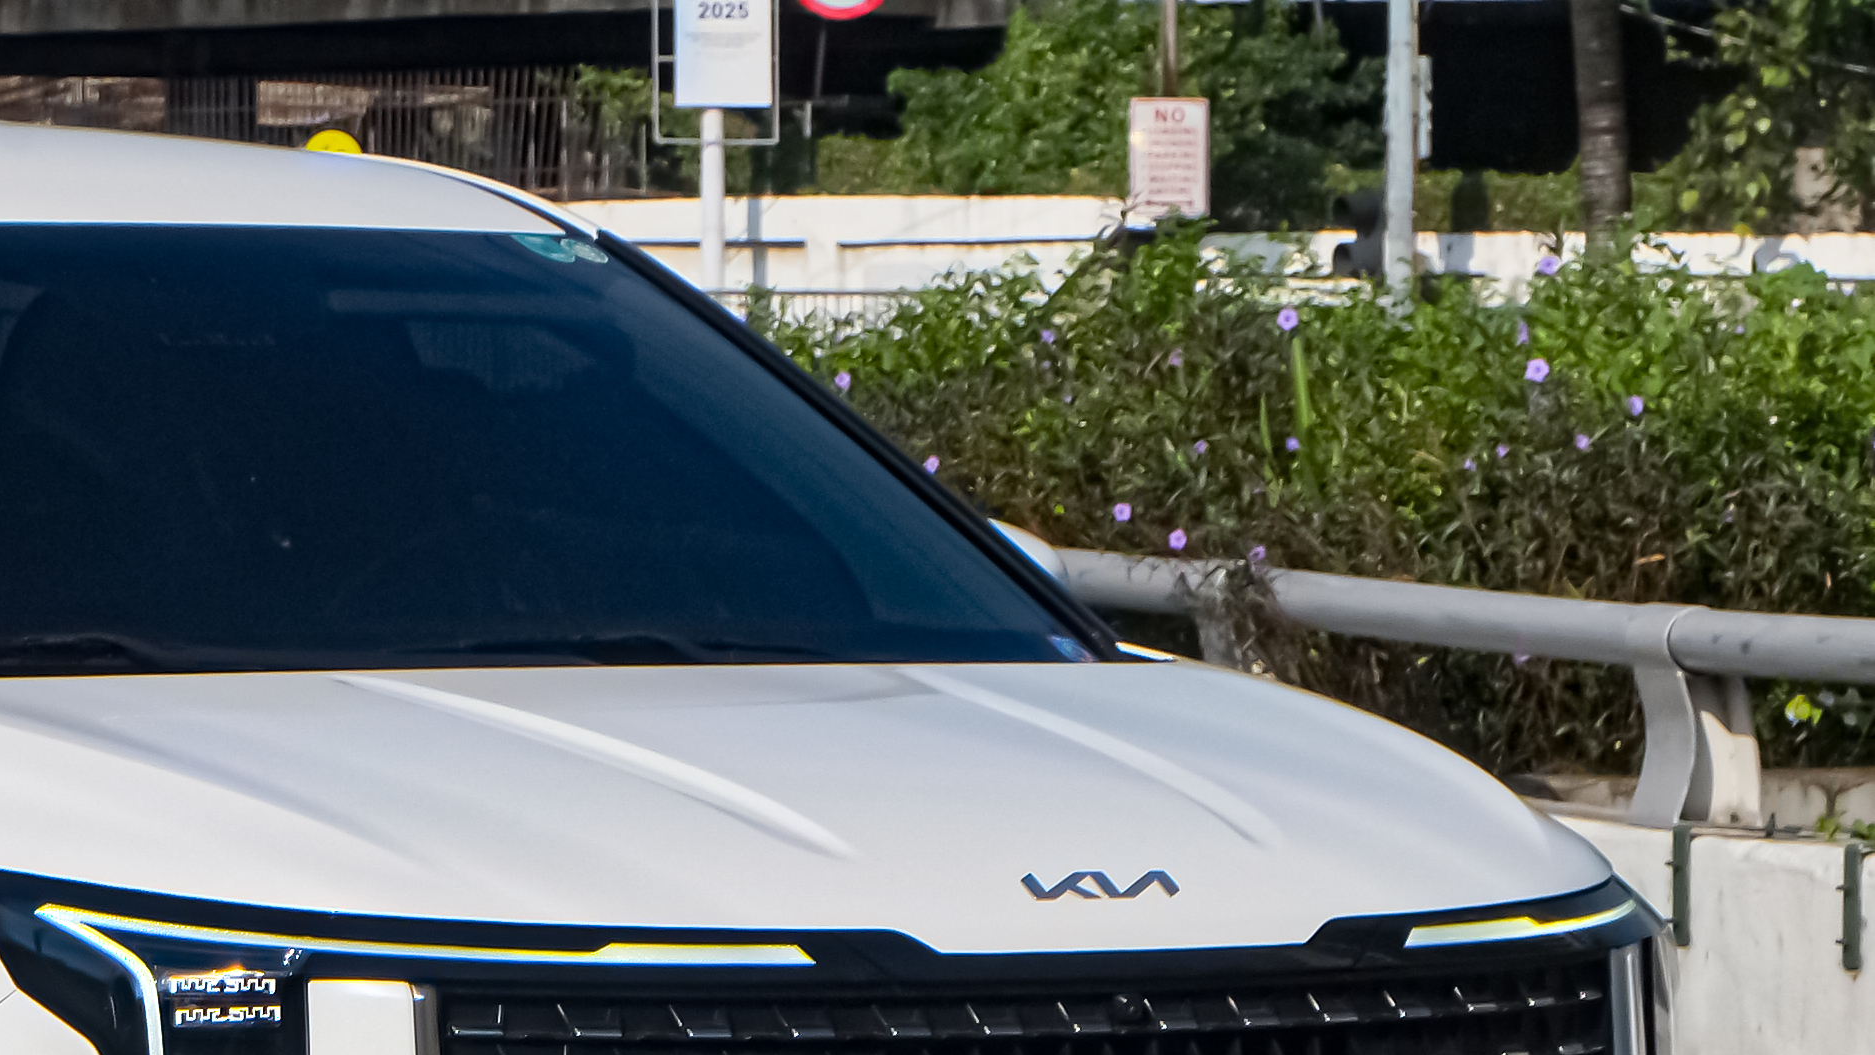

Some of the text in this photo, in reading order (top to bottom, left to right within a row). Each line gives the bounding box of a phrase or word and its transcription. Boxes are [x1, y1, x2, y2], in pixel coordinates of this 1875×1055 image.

[698, 1, 749, 19] 2025
[1154, 106, 1186, 123] NO
[1021, 869, 1181, 901] KIA
